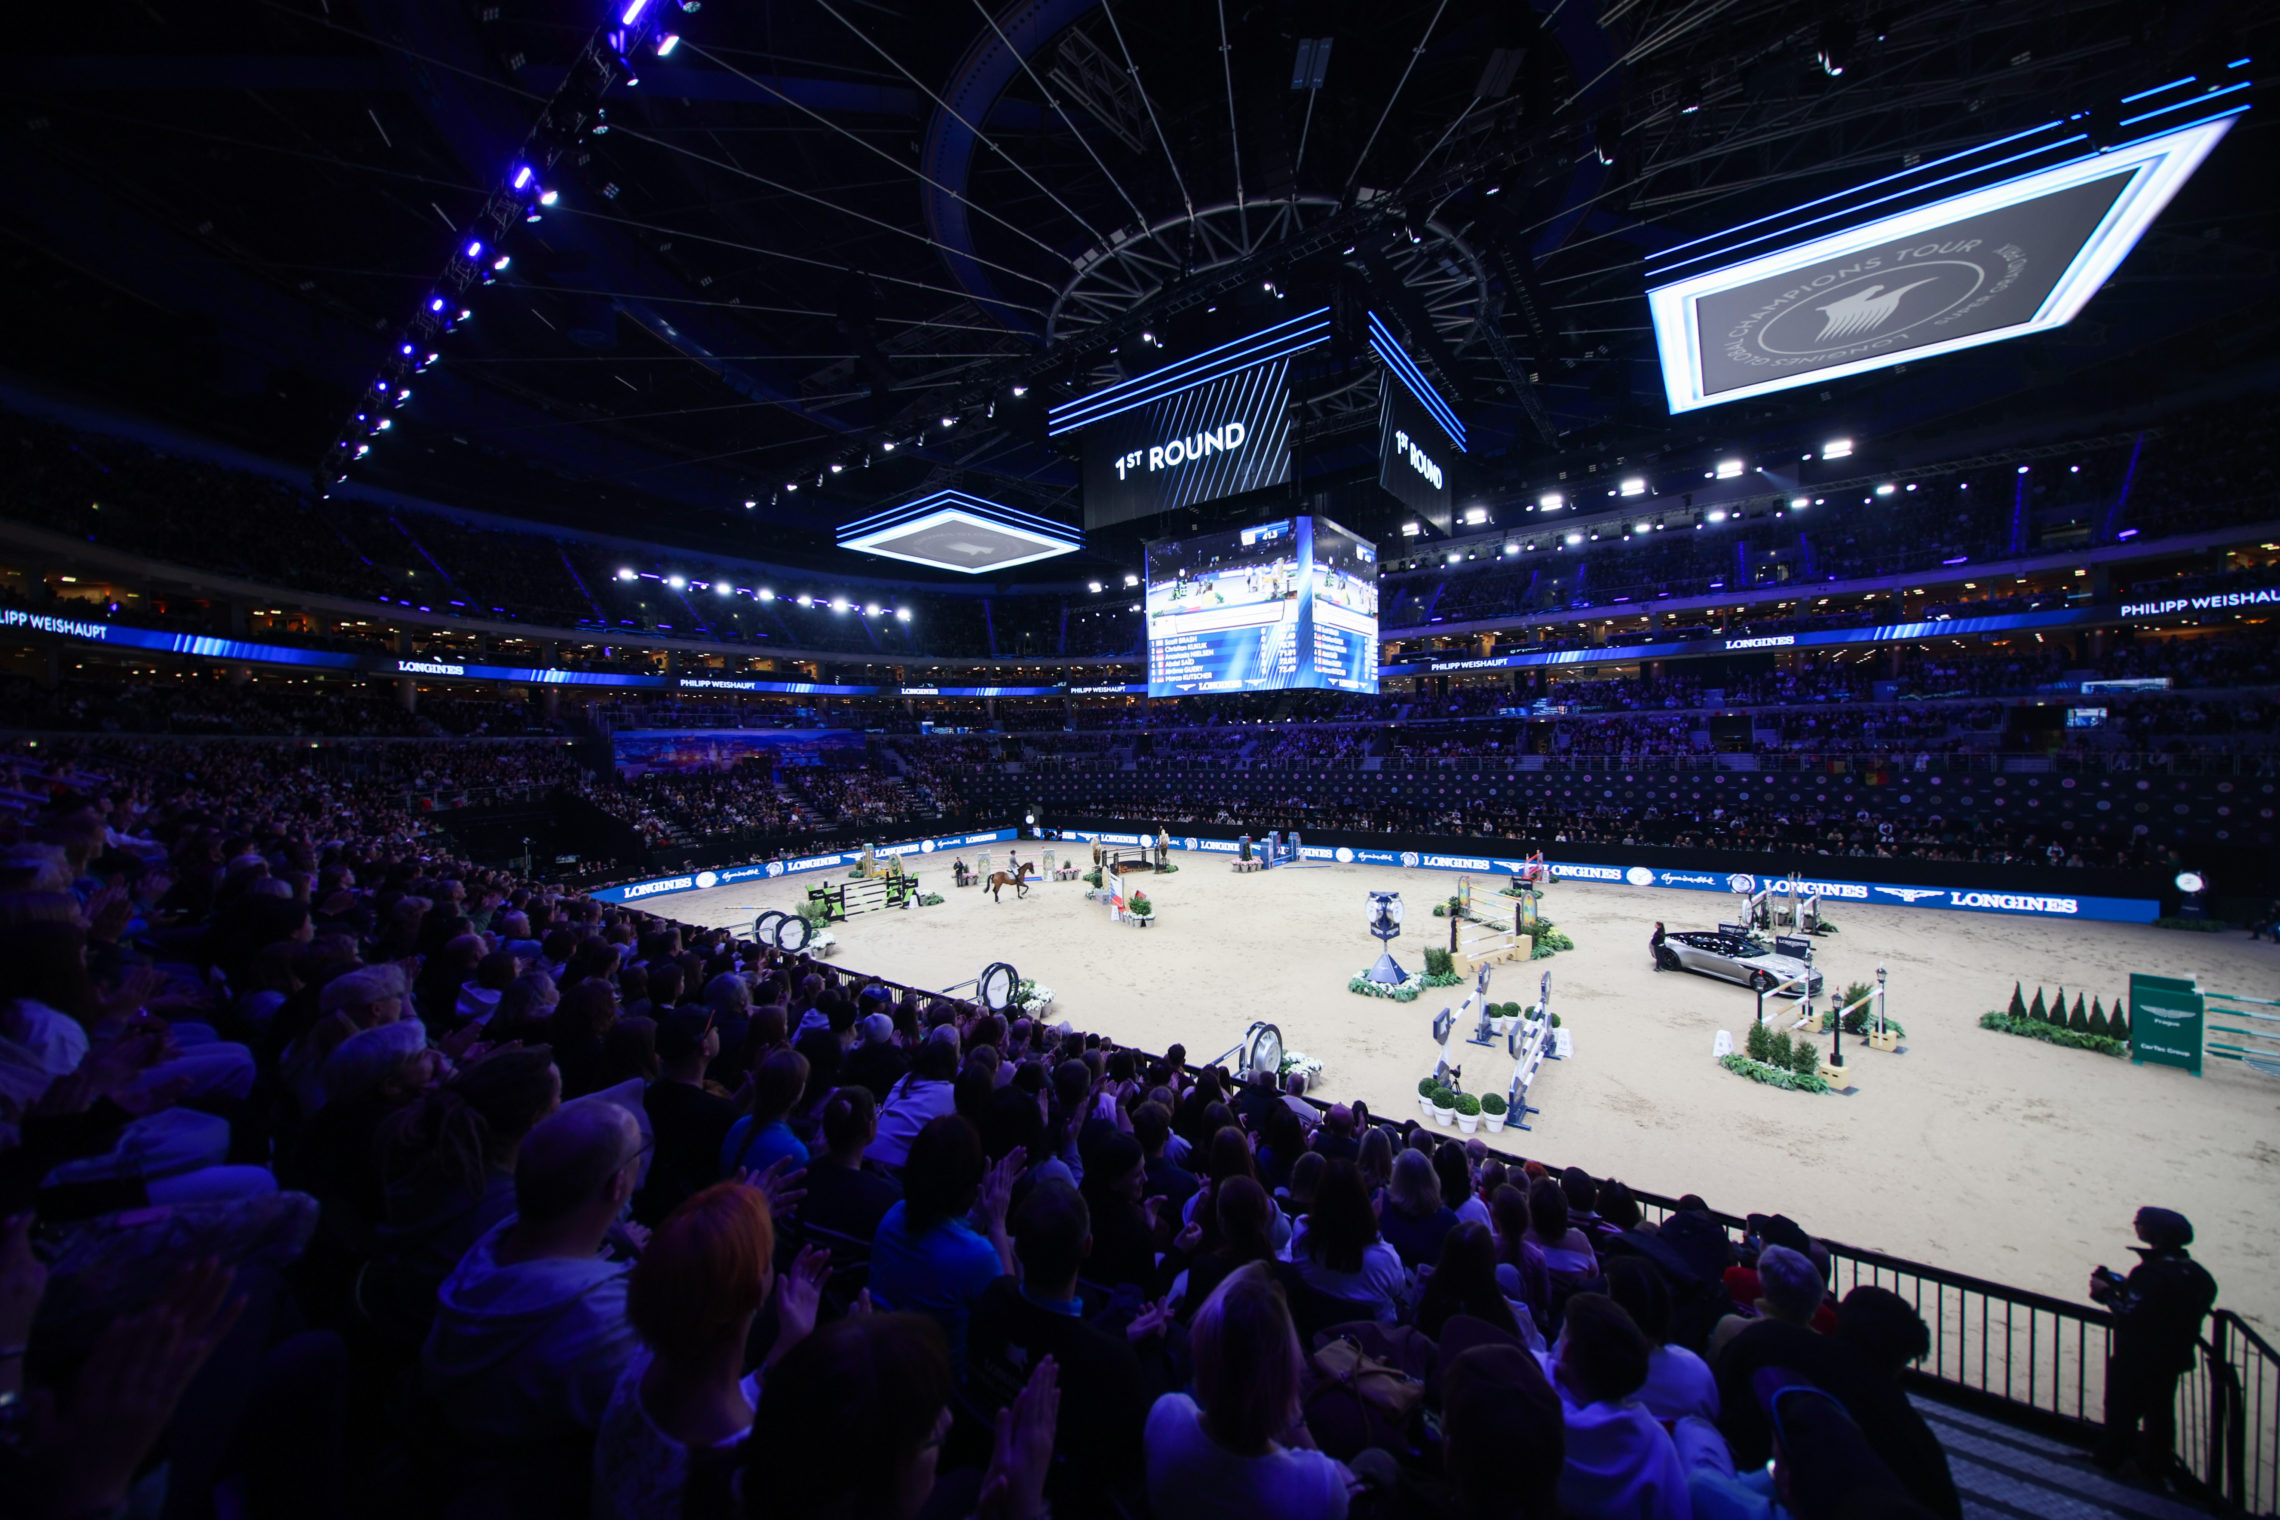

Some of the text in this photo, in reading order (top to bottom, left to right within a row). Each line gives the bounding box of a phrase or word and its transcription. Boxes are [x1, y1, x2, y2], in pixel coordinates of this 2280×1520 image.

[1728, 257, 1881, 338] CHAMPIONS
[1896, 239, 1983, 261] TOUR
[1115, 422, 1246, 481] 1ST ROUND
[1410, 442, 1443, 490] ROUND
[2120, 599, 2189, 617] PHILIPP
[29, 613, 107, 640] WEISHAUPT
[1725, 635, 1795, 650] LONGINES
[398, 660, 464, 676] LONGINES
[1431, 658, 1508, 671] PHILIPP WEISHAUPT
[680, 679, 756, 690] PHILIPP WEISHAUPT
[900, 687, 939, 695] LONGINES
[1092, 685, 1126, 693] WEISHAUPT
[1200, 840, 1240, 852] LONGINE
[787, 855, 841, 872] LONGINES
[875, 843, 920, 858] LONGINES
[1423, 856, 1490, 870] LONGINES
[624, 877, 692, 898] LONGINES
[1763, 878, 1869, 898] LONGINES
[1950, 891, 2079, 914] LONGINES
